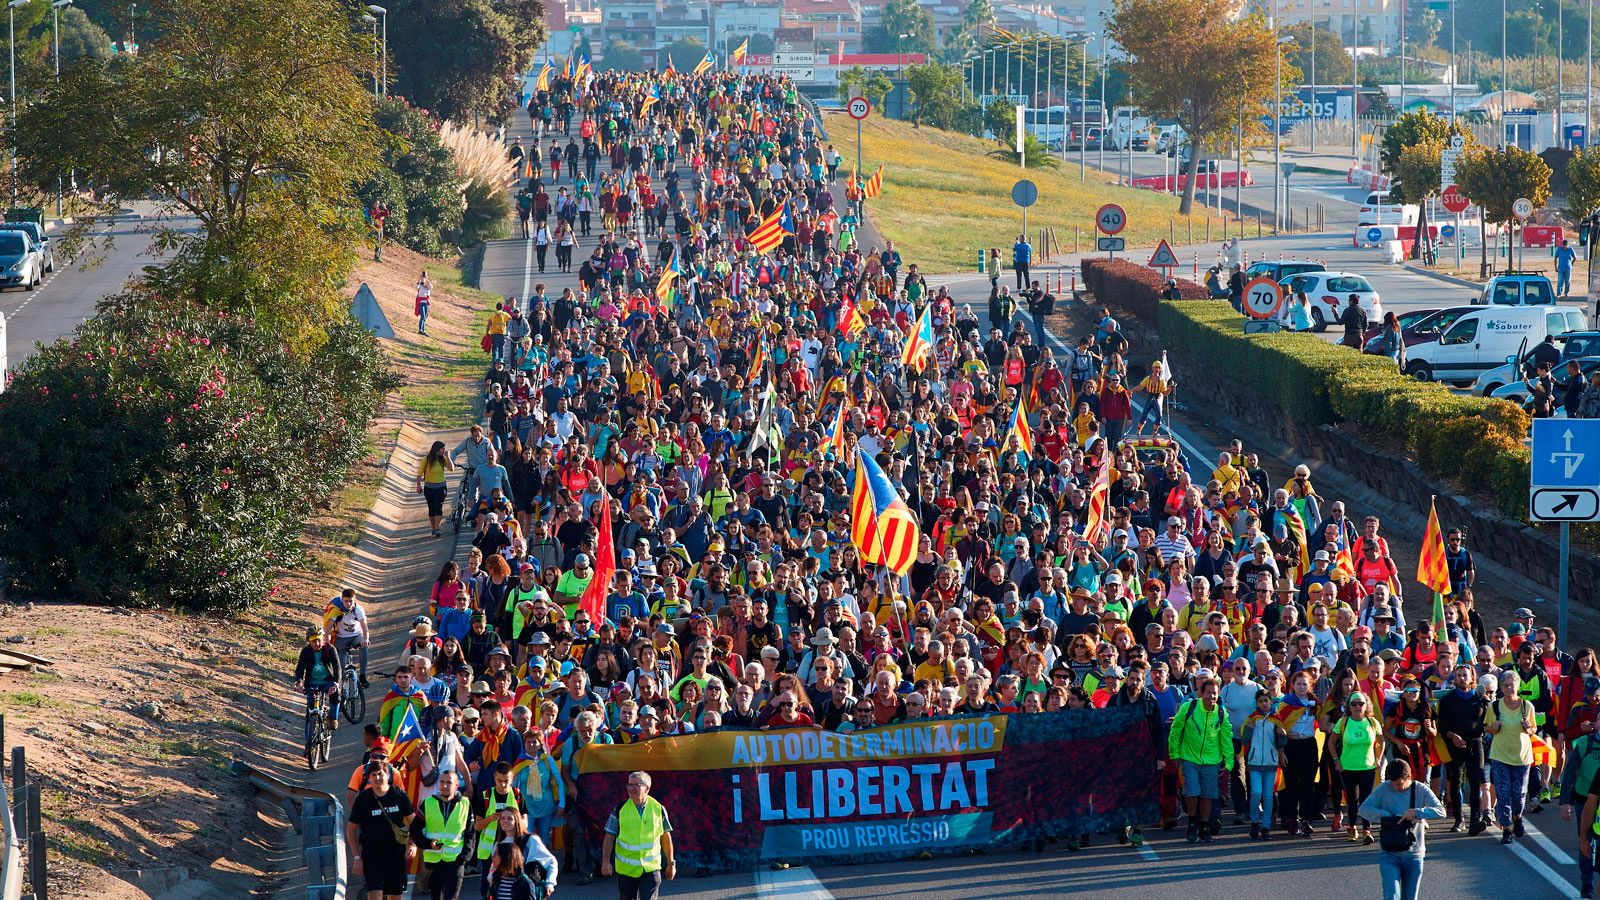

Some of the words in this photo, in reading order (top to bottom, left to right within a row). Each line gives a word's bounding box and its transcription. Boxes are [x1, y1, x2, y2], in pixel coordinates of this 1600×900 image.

[853, 103, 865, 113] 70
[1516, 203, 1528, 214] 30
[1101, 214, 1121, 225] 40
[1252, 292, 1273, 305] 70
[732, 714, 994, 764] AUTODETERMINACIÓ
[732, 774, 743, 823] i
[758, 759, 995, 821] LLIBERTAT
[802, 825, 850, 850] PROU
[856, 815, 949, 848] REPRESSIÓ
